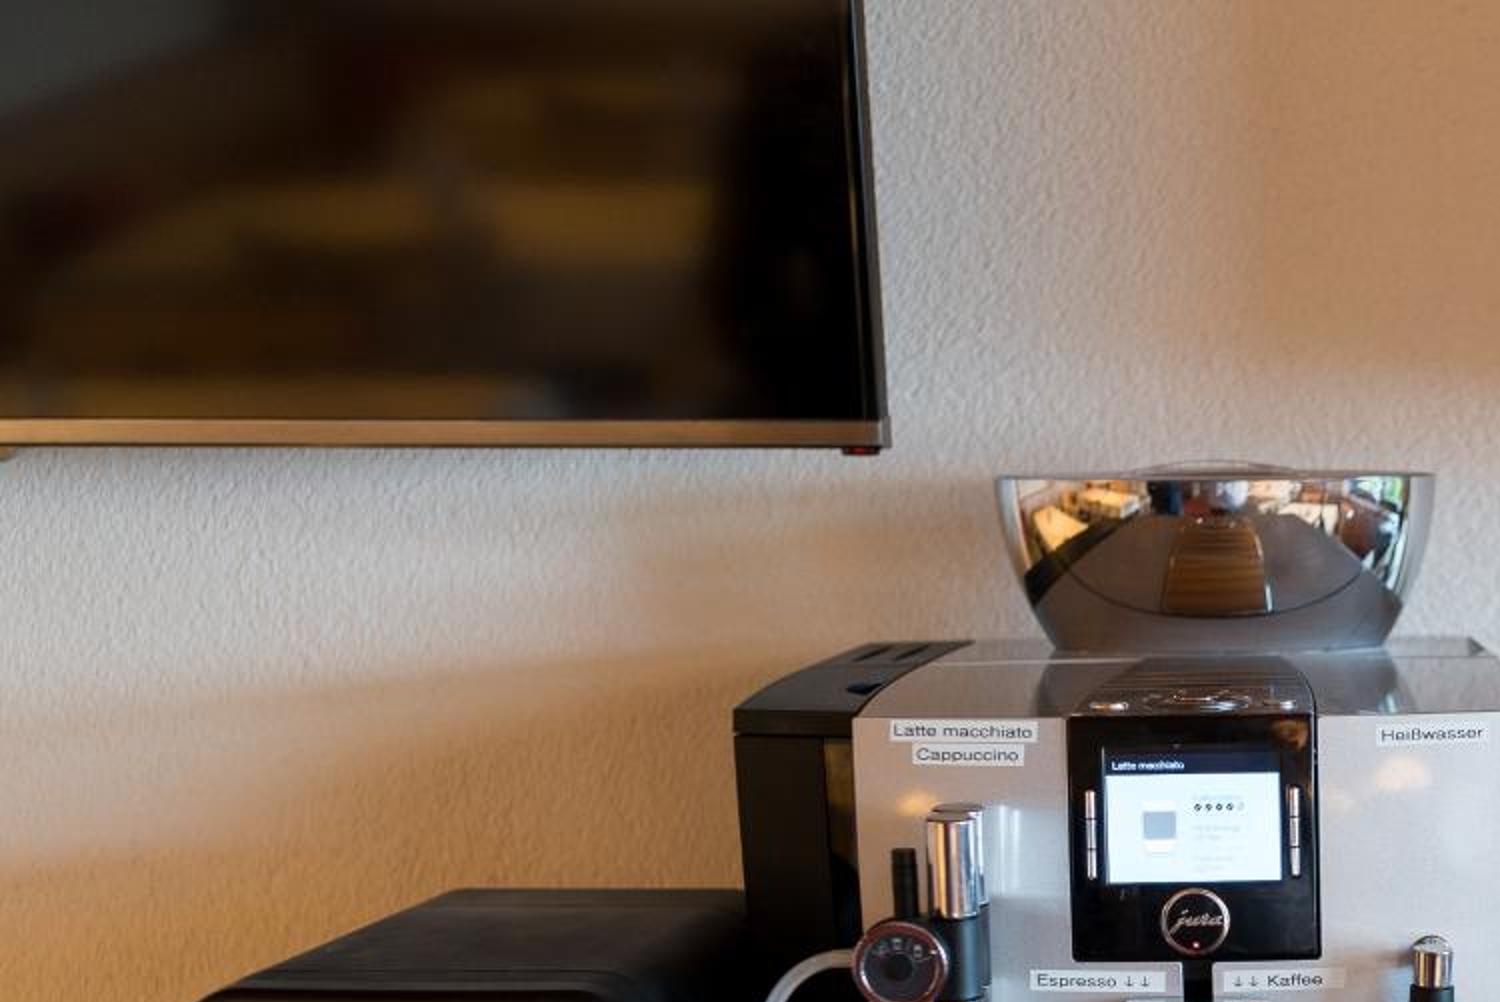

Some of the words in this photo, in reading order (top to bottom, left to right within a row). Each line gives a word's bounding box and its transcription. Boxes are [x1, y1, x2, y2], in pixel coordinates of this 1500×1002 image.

[893, 723, 937, 738] Latte
[943, 725, 1033, 739] macchiato
[916, 747, 1019, 762] Cappuccino
[1111, 760, 1136, 771] Latte
[1036, 973, 1117, 988] Espresso
[1266, 972, 1323, 987] Kaffee
